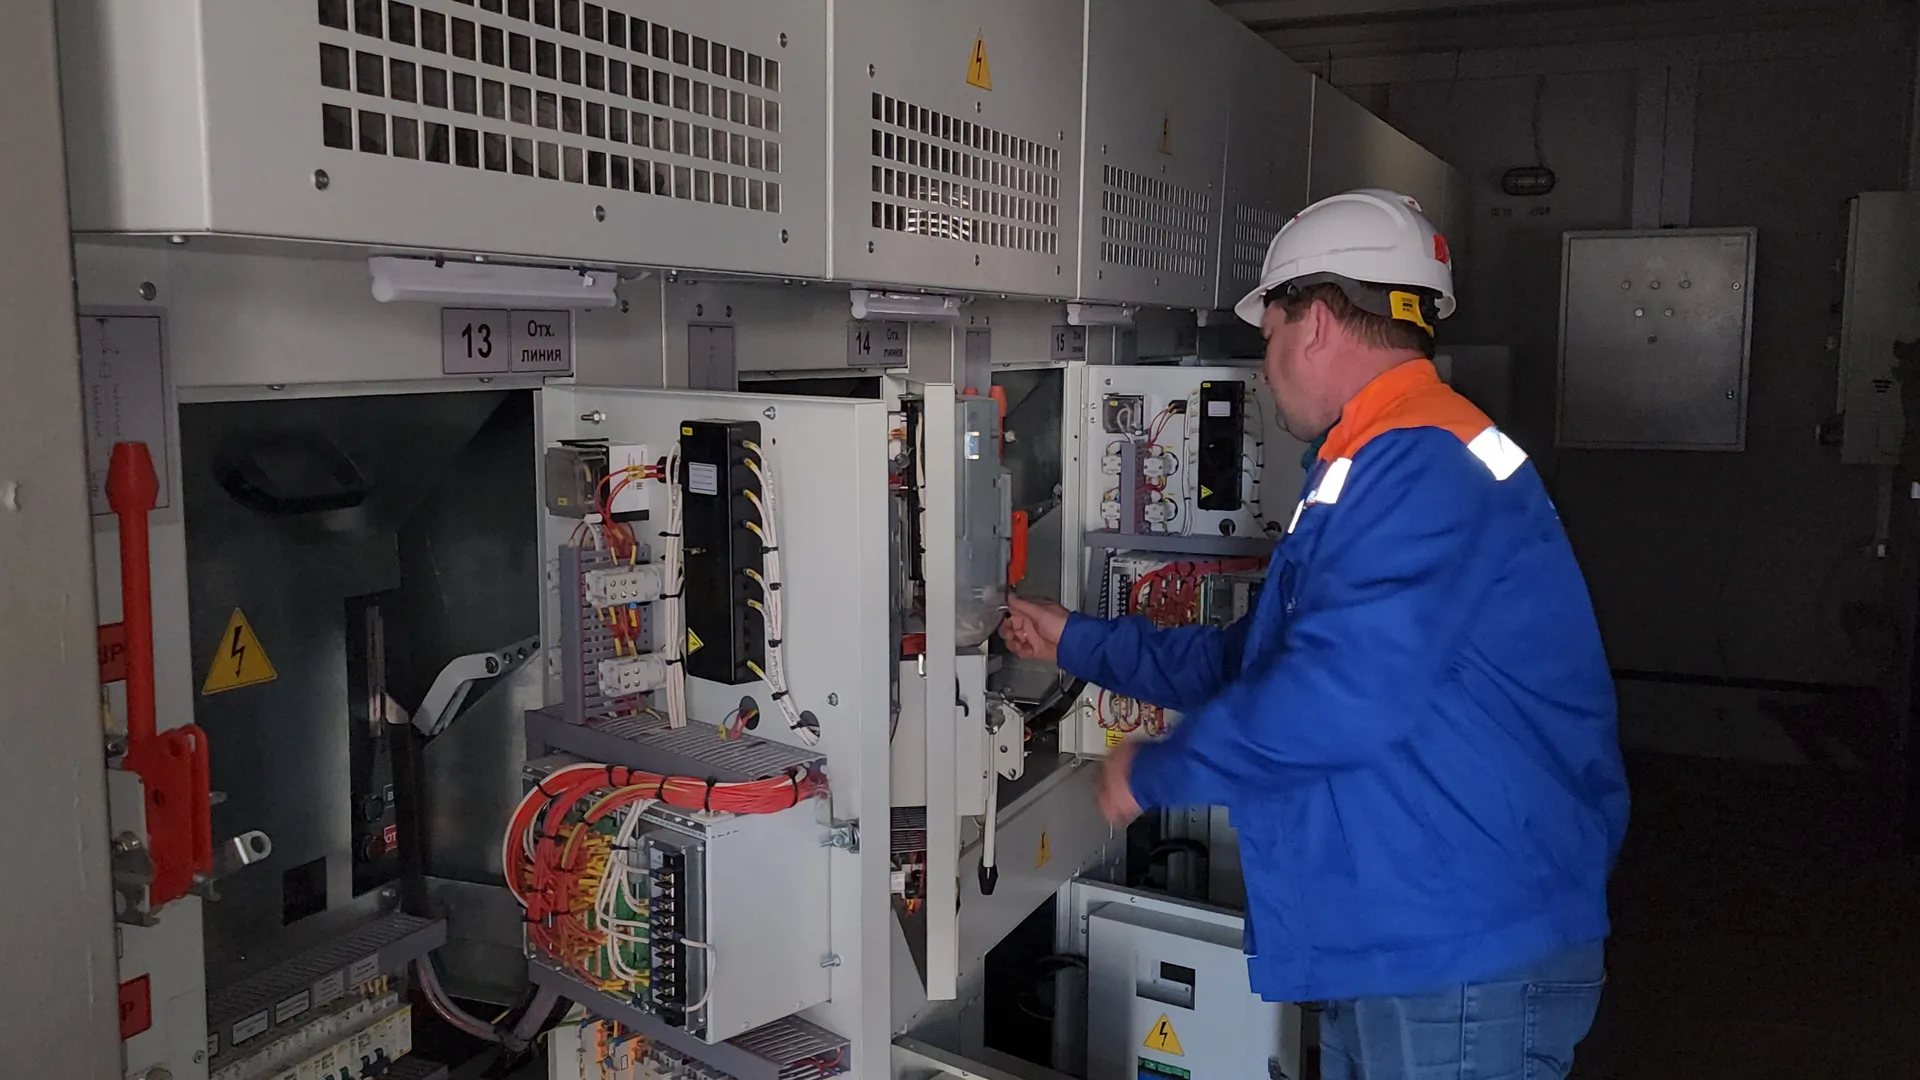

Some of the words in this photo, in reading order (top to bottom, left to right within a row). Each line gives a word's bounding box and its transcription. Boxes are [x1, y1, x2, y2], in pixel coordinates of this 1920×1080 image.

[527, 319, 555, 337] Отх.
[461, 322, 492, 359] 13
[855, 331, 871, 356] 14
[1056, 332, 1065, 352] 15
[520, 348, 562, 363] линия
